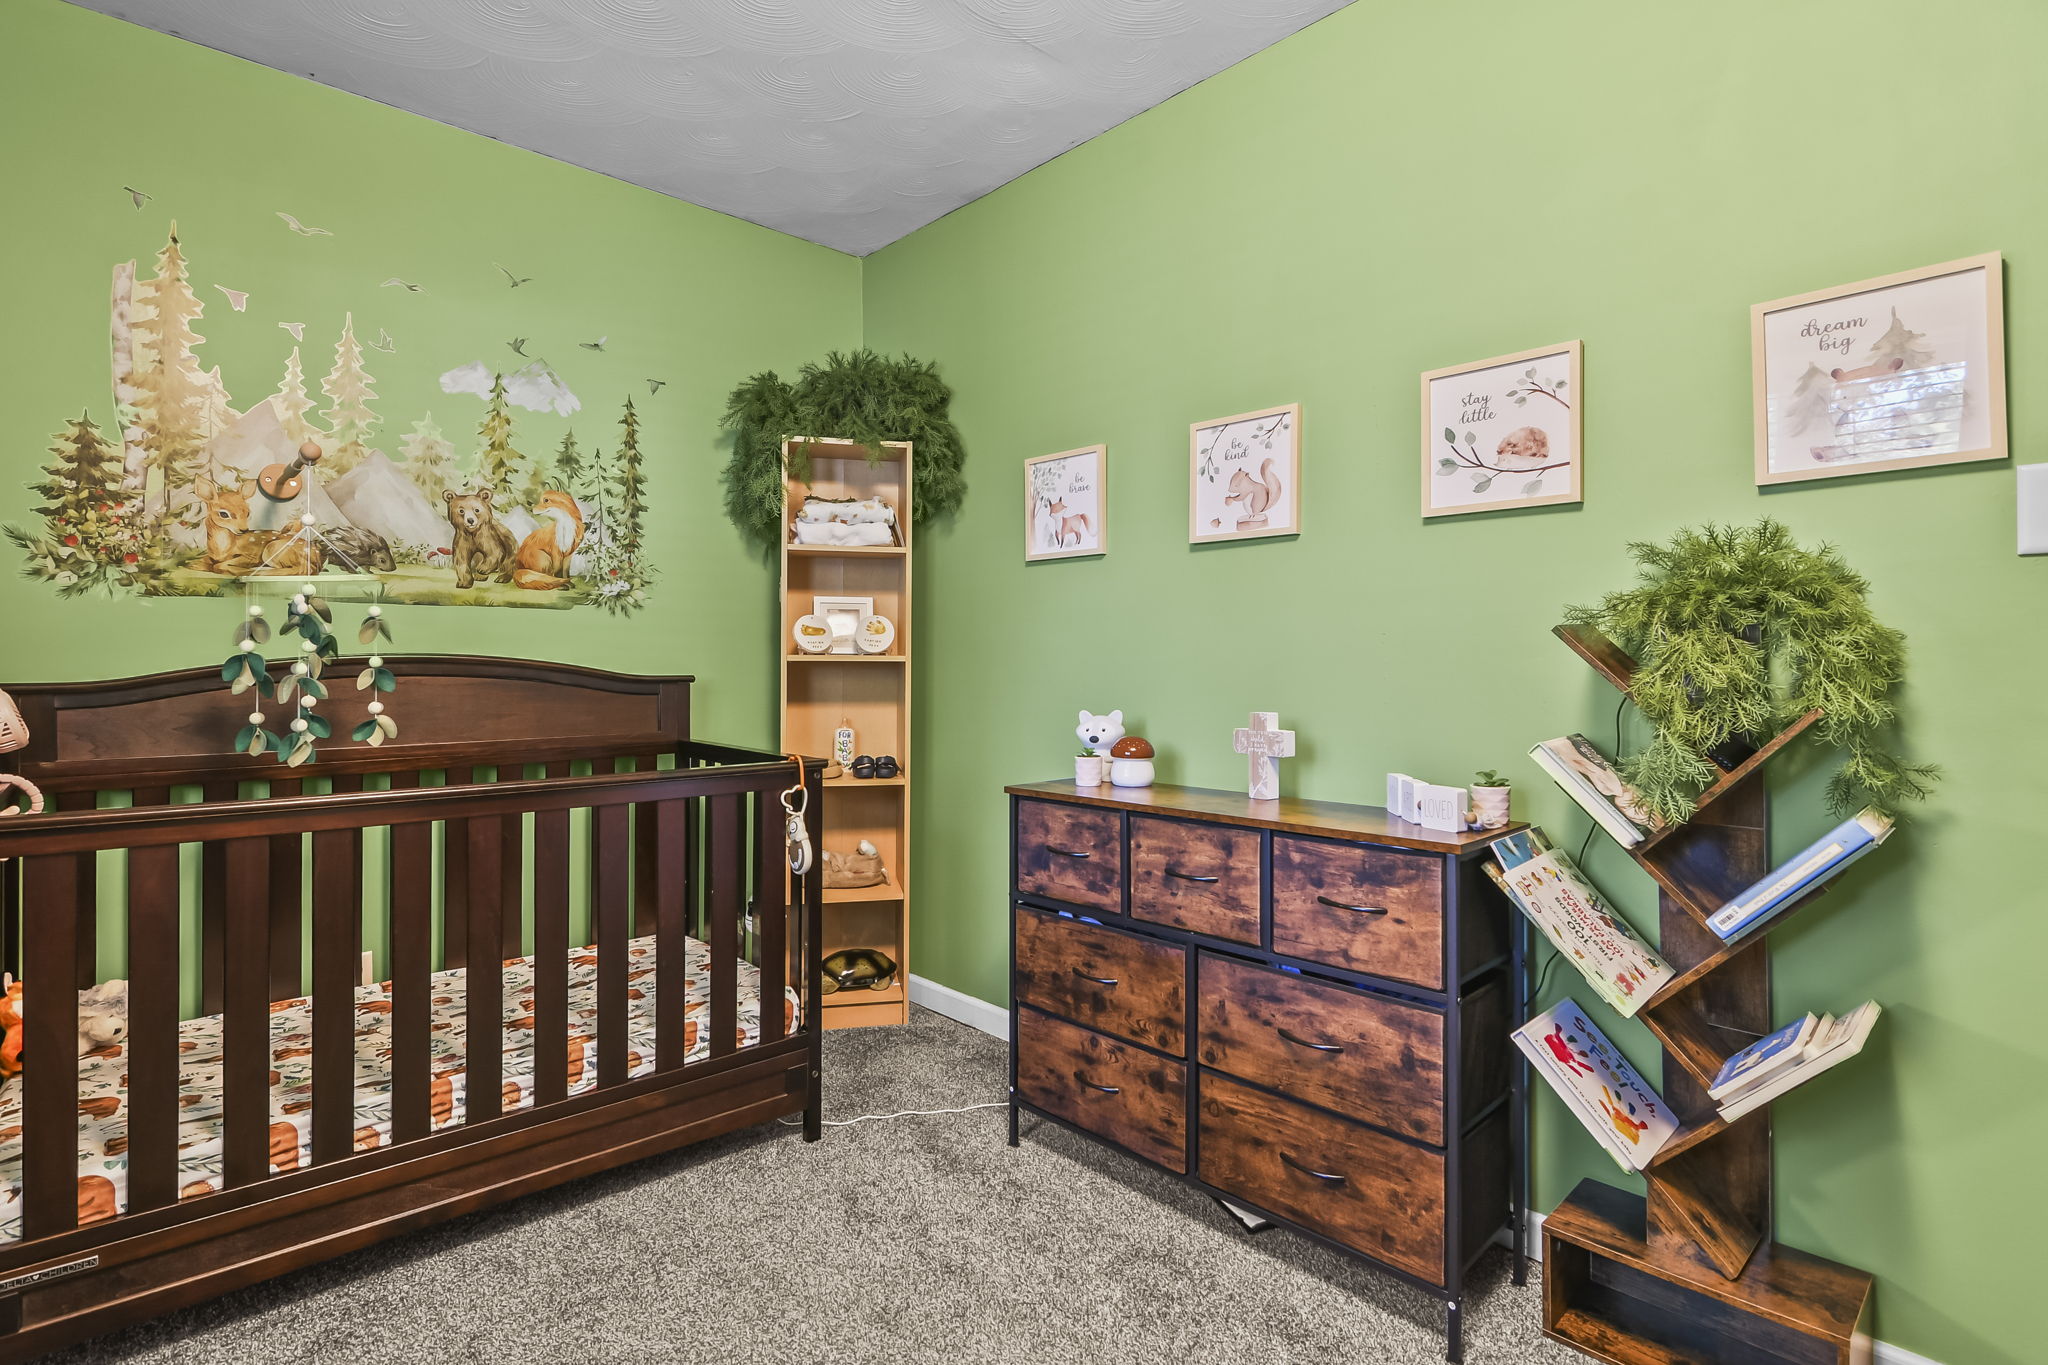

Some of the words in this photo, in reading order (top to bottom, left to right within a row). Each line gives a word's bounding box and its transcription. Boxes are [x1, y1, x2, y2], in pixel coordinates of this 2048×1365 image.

[1800, 316, 1868, 339] dream
[1819, 334, 1857, 355] big
[1461, 392, 1492, 409] stay
[1459, 407, 1497, 425] little
[1224, 445, 1250, 461] kind
[1231, 437, 1243, 449] be
[1069, 482, 1090, 494] brave
[1074, 472, 1086, 483] be
[838, 731, 852, 739] FOR
[1423, 799, 1454, 820] LOVED
[1554, 896, 1585, 931] WORDS
[1561, 888, 1605, 938] PALABRAS
[1562, 896, 1599, 938] PRIMERAS
[1566, 920, 1590, 945] 100
[1587, 934, 1613, 961] FIRST
[1600, 939, 1616, 956] LAS
[1606, 939, 1625, 958] 100
[1588, 1045, 1628, 1088] Feel
[0, 1274, 33, 1290] DELTA
[40, 1259, 98, 1280] CHILDREN
